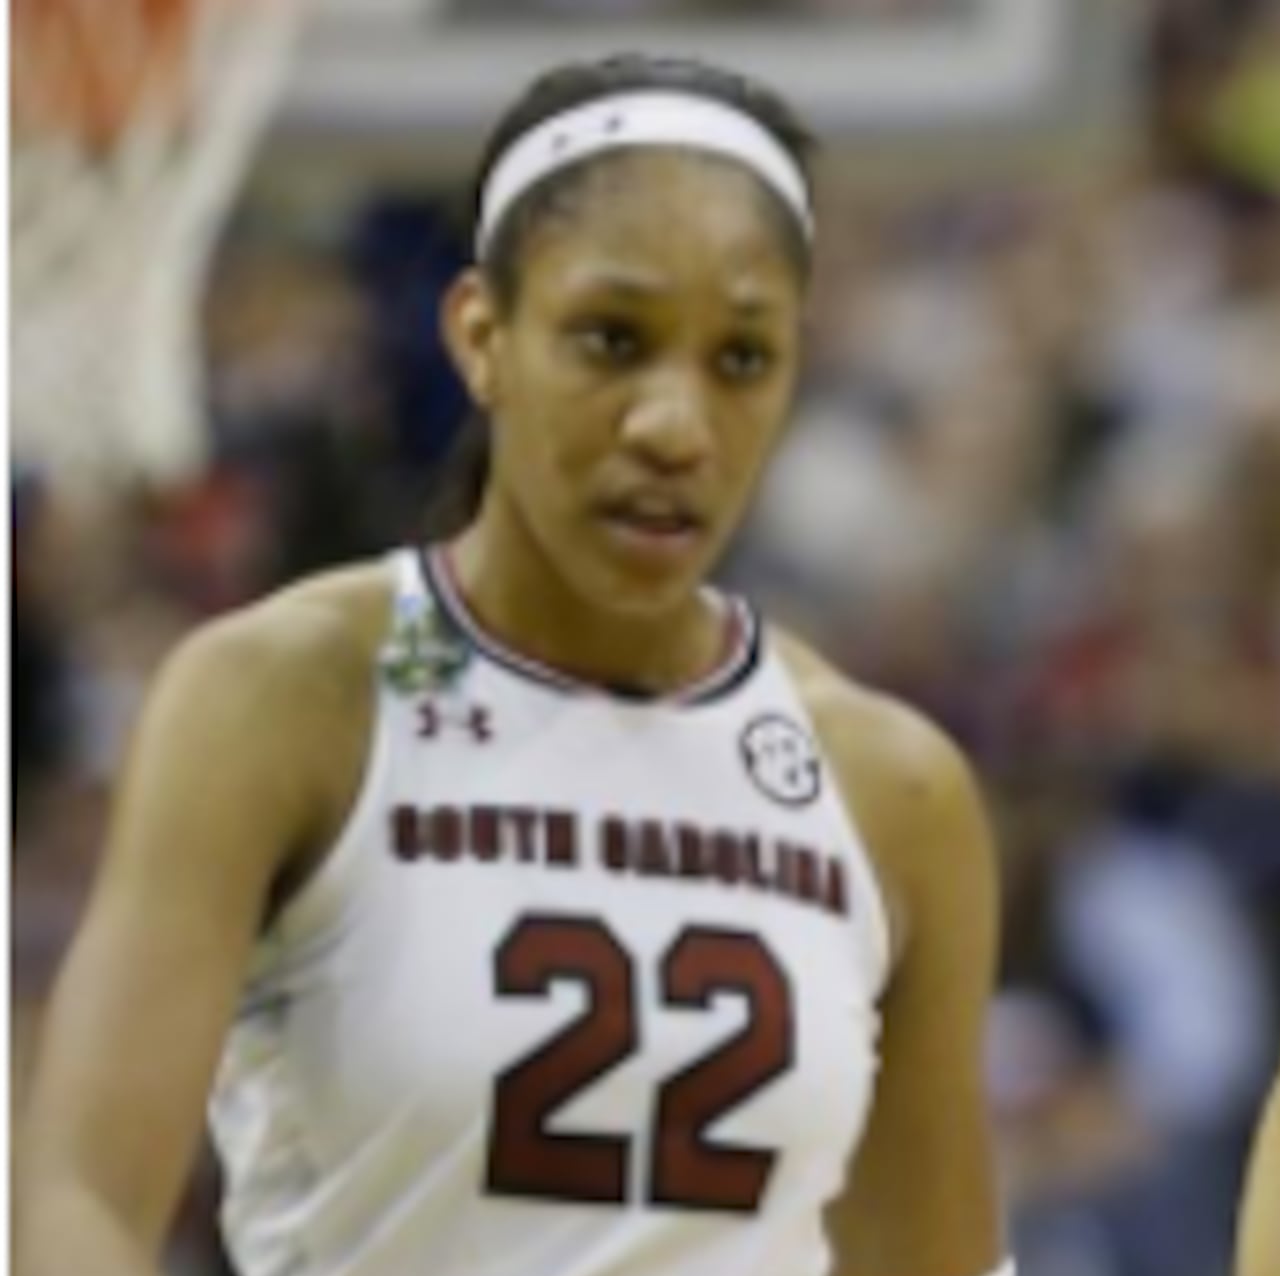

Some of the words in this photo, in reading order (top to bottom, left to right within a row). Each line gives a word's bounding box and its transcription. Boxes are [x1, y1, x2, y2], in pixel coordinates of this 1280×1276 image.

[391, 805, 577, 867] SOUTH
[603, 815, 849, 916] CAROLINA
[484, 911, 795, 1214] 22
